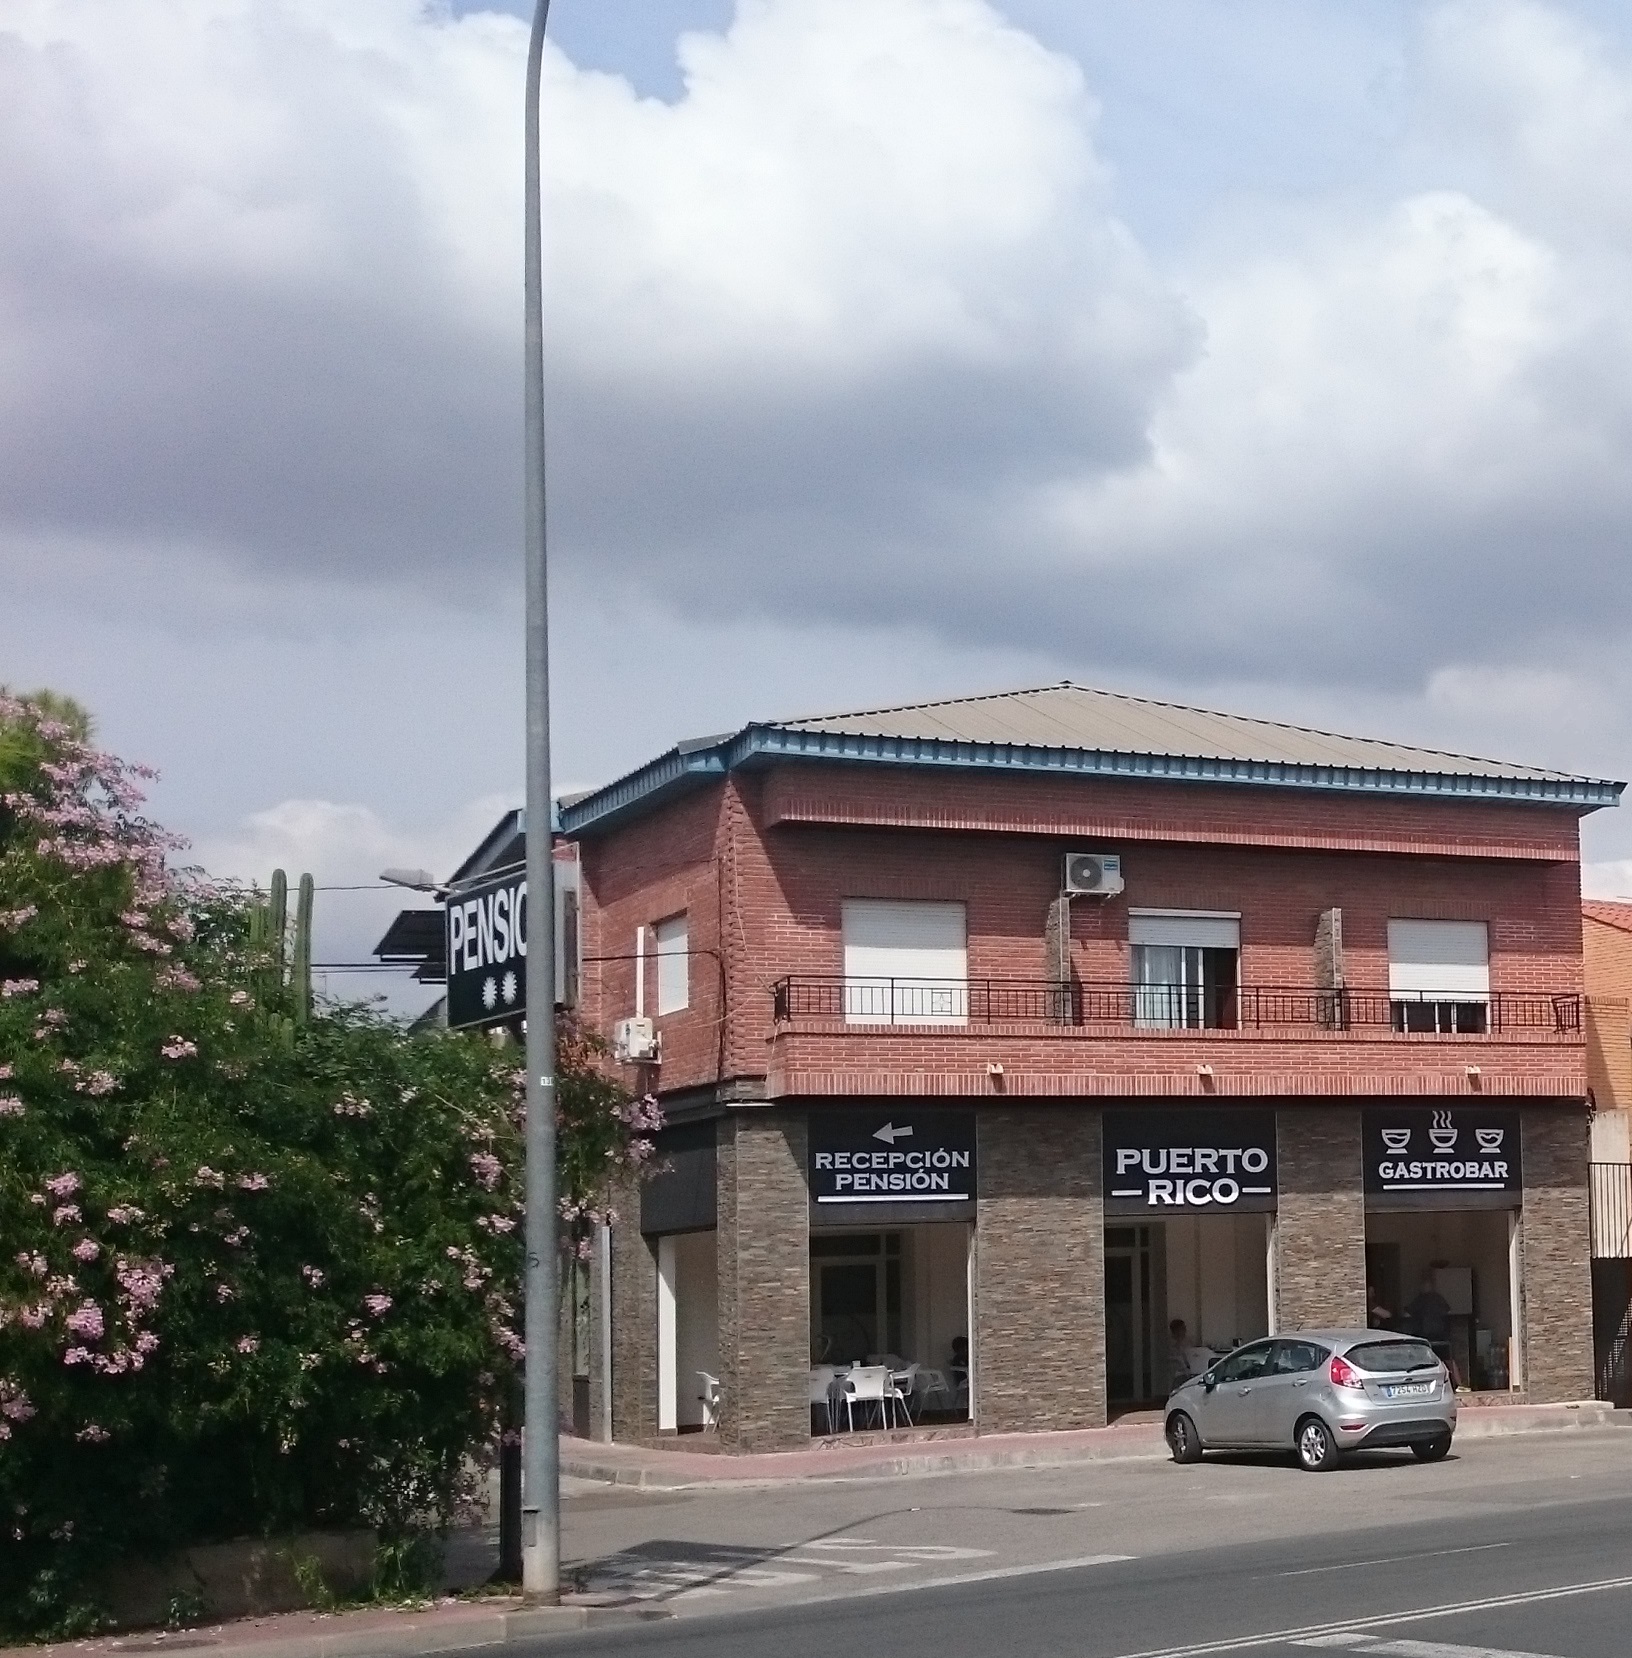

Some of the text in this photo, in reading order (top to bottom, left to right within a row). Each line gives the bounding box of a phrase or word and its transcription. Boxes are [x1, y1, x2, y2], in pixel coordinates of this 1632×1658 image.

[815, 1148, 970, 1169] RECEPCIÓN
[1116, 1147, 1268, 1174] PUERTO
[835, 1169, 949, 1190] PENSIÓN
[1378, 1161, 1509, 1179] GASTROBAR
[1148, 1178, 1239, 1205] RICO
